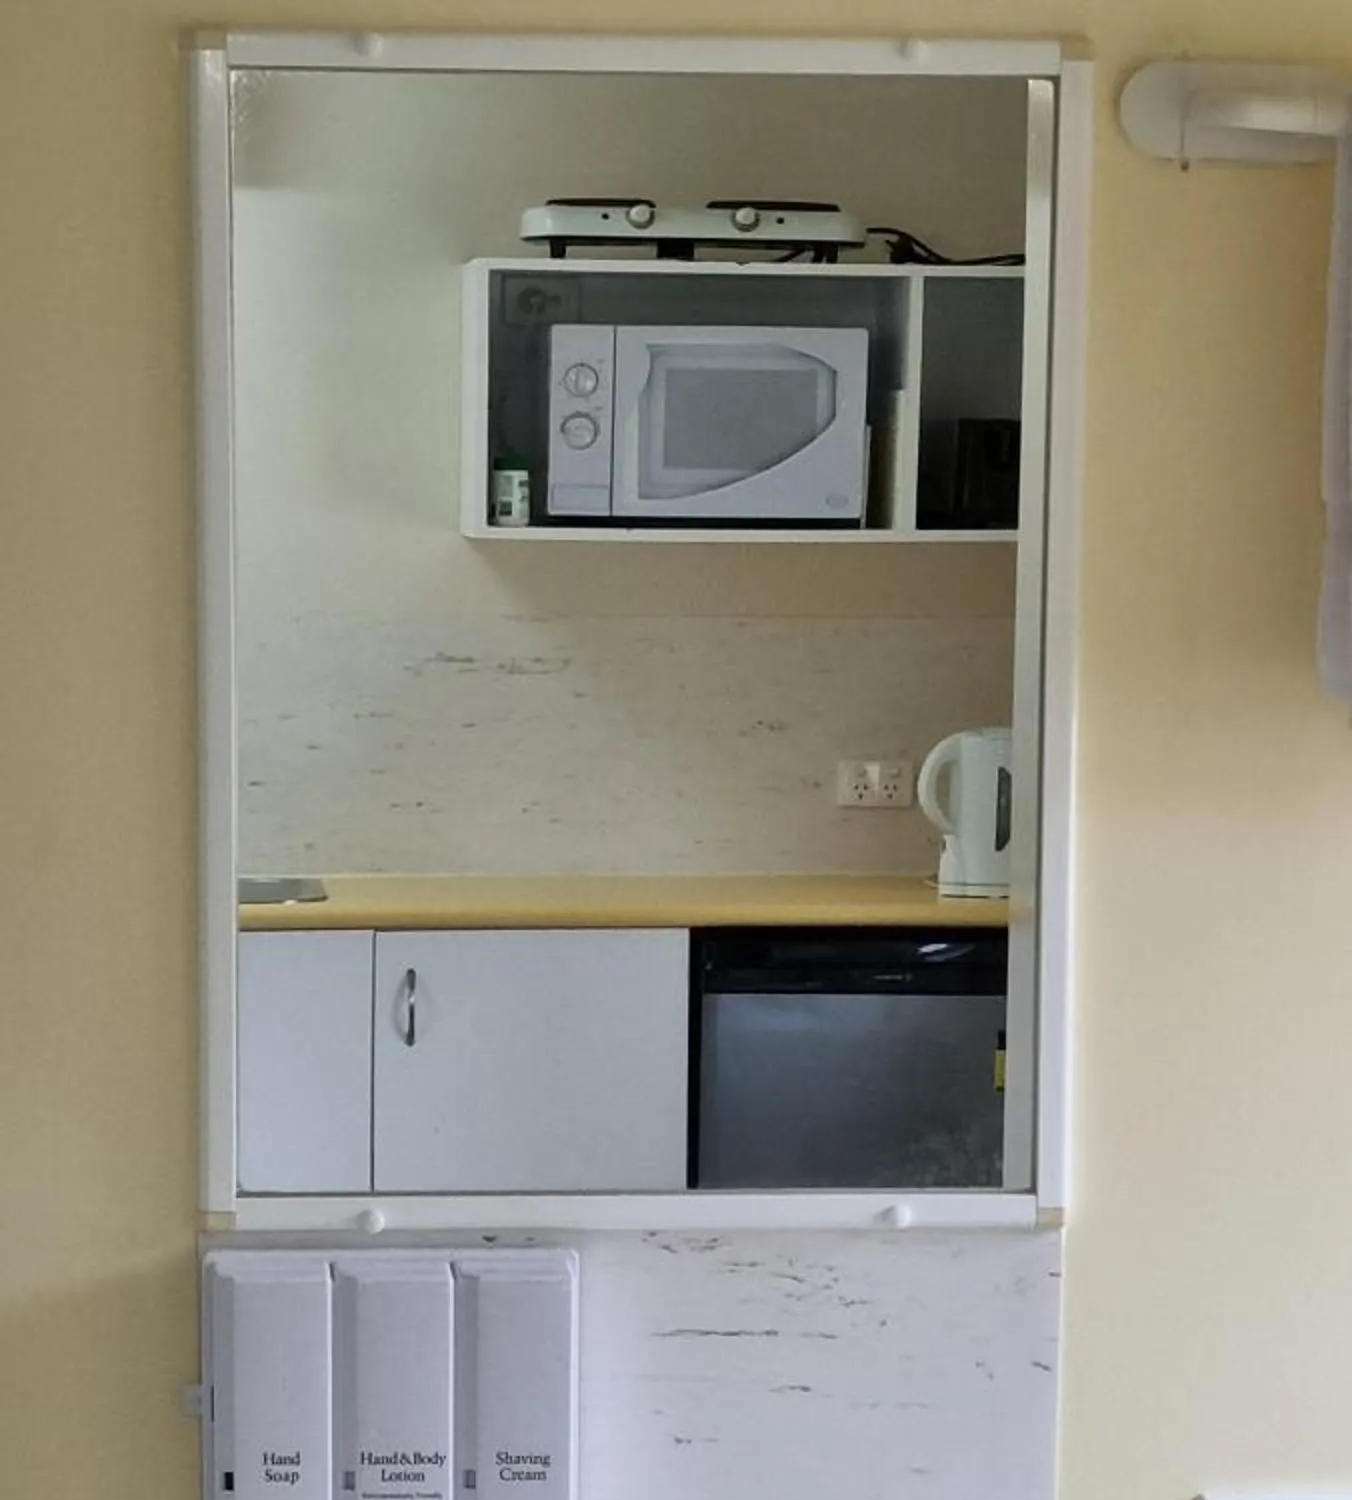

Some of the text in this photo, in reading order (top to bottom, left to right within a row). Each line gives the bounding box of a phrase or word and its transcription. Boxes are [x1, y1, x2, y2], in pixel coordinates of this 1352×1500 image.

[263, 1451, 300, 1466] Hand
[495, 1451, 550, 1468] Shaving
[265, 1467, 300, 1485] Soap
[381, 1468, 425, 1481] Lotion
[499, 1466, 547, 1481] Cream
